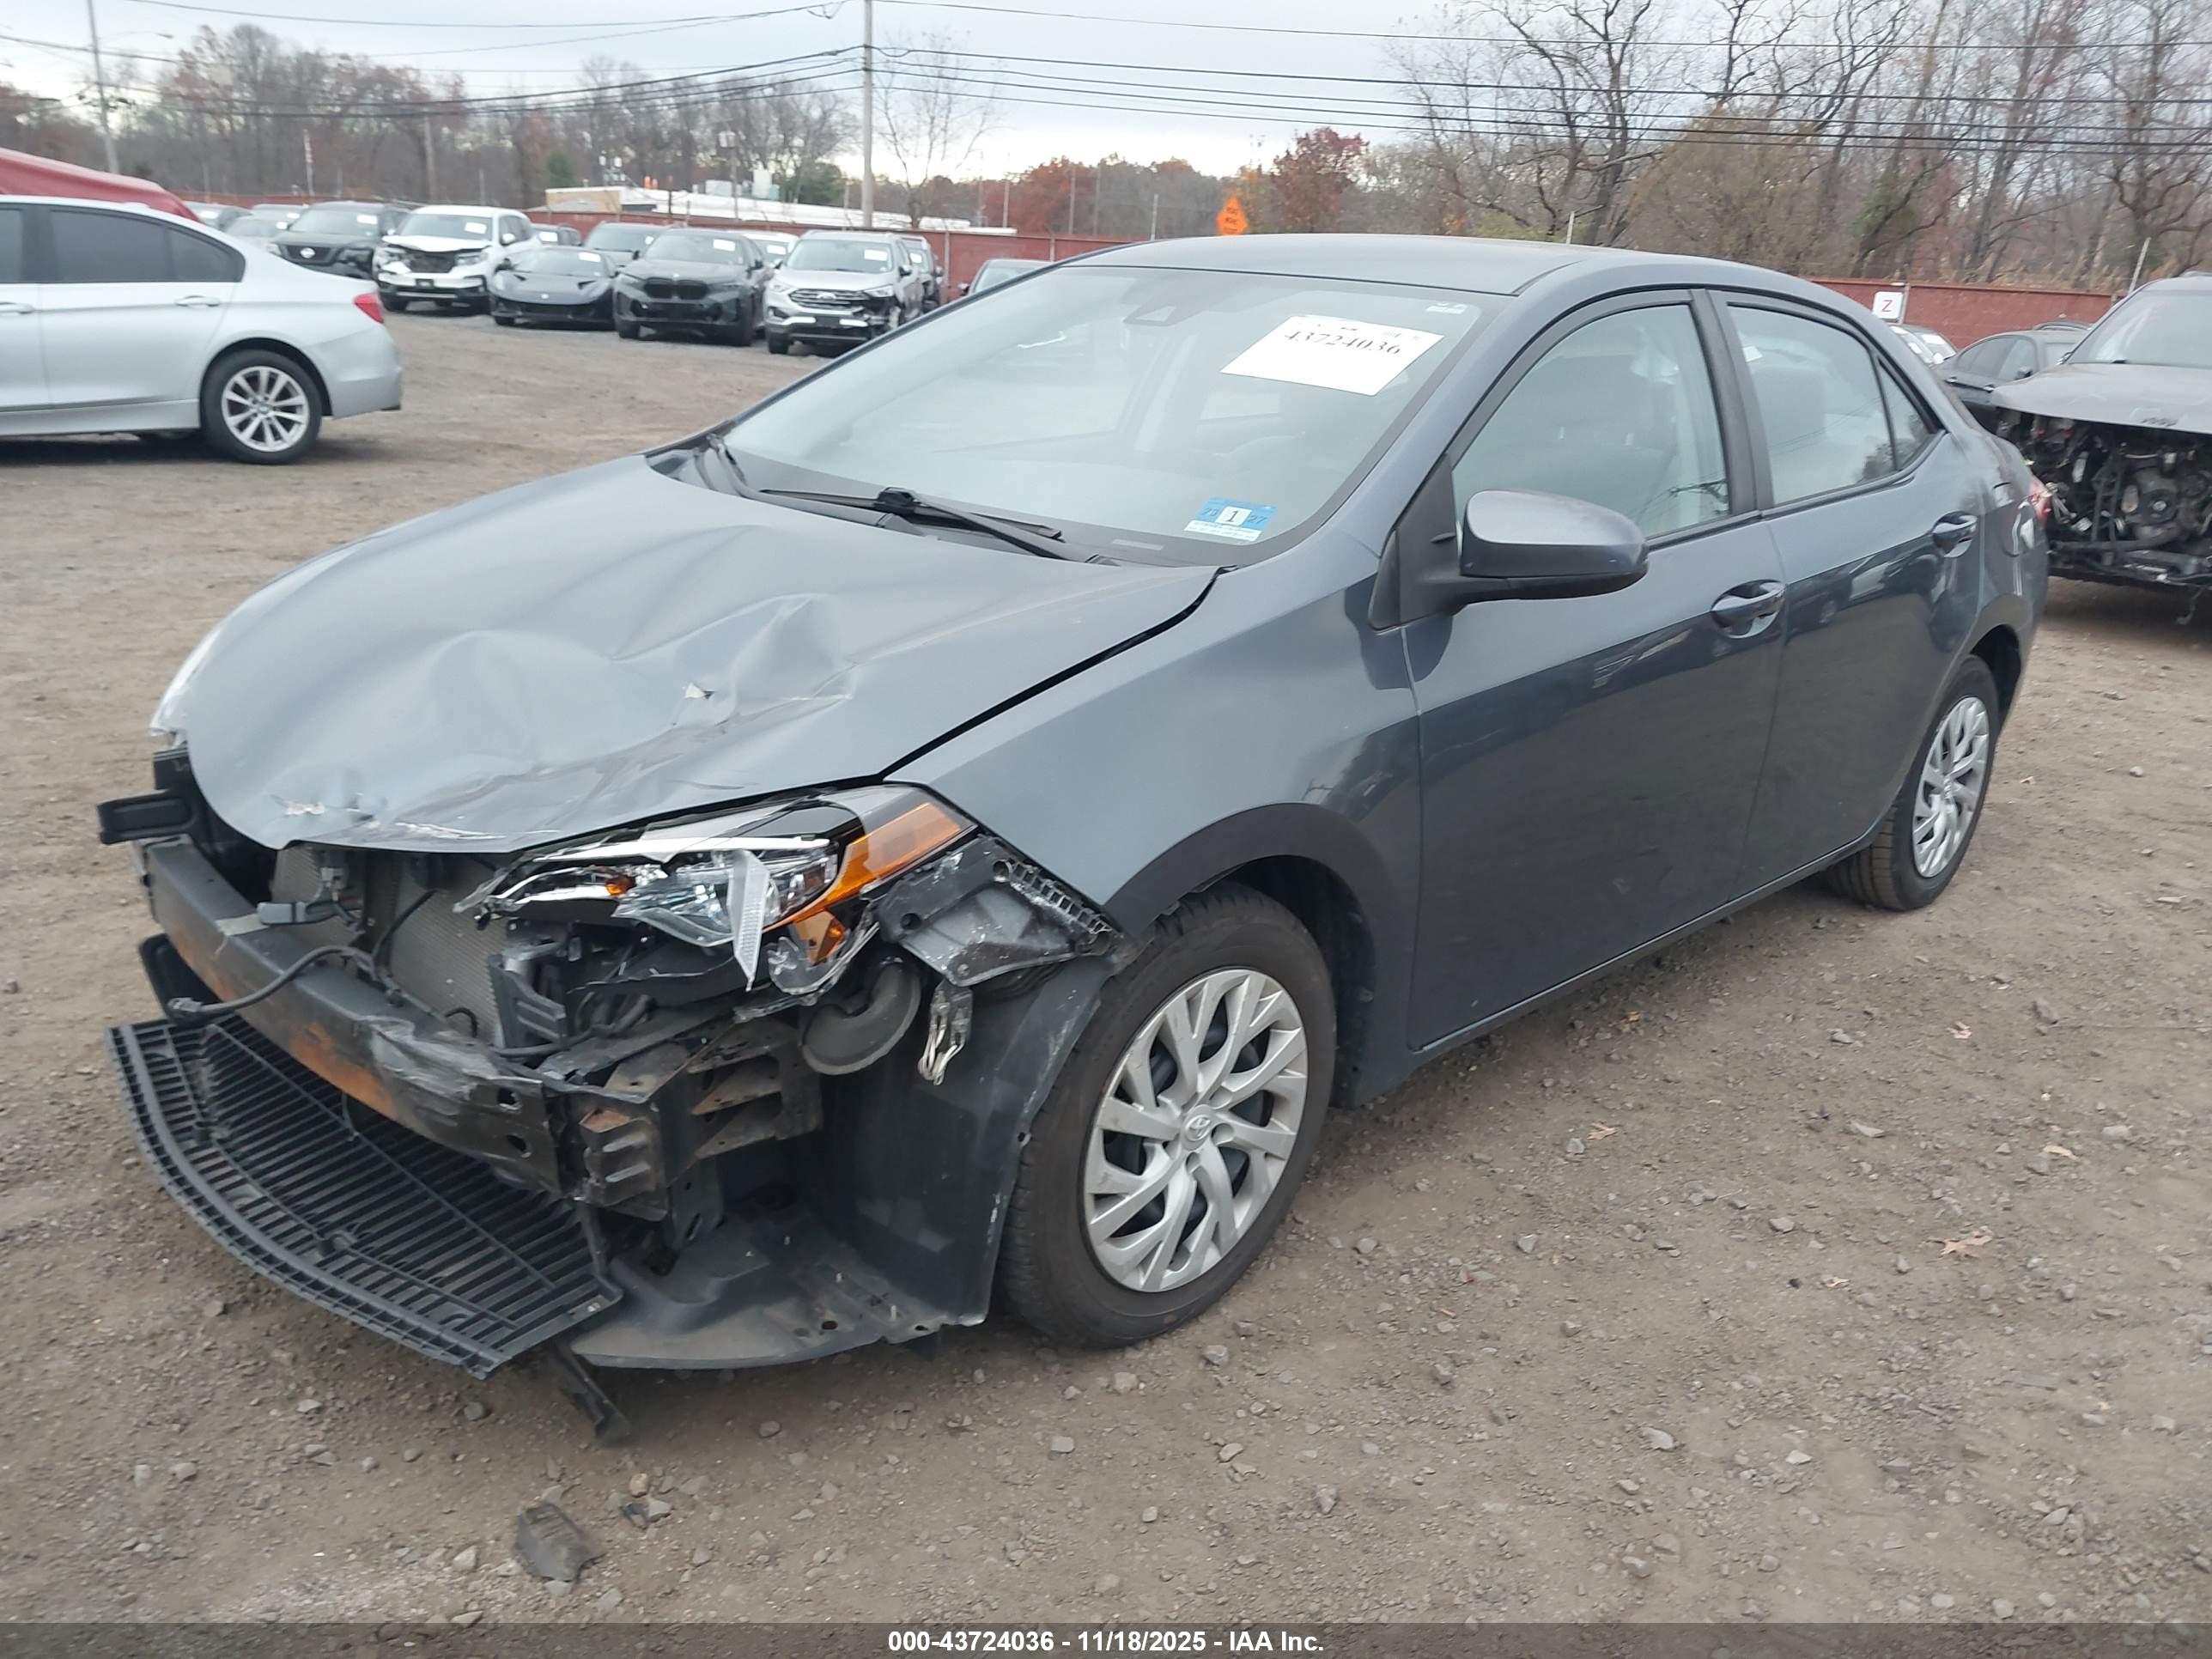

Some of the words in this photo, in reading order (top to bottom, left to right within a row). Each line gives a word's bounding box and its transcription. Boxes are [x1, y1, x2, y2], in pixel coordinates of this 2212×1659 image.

[1881, 299, 1893, 313] Z
[1285, 330, 1401, 355] 43724036
[1226, 510, 1239, 522] 1
